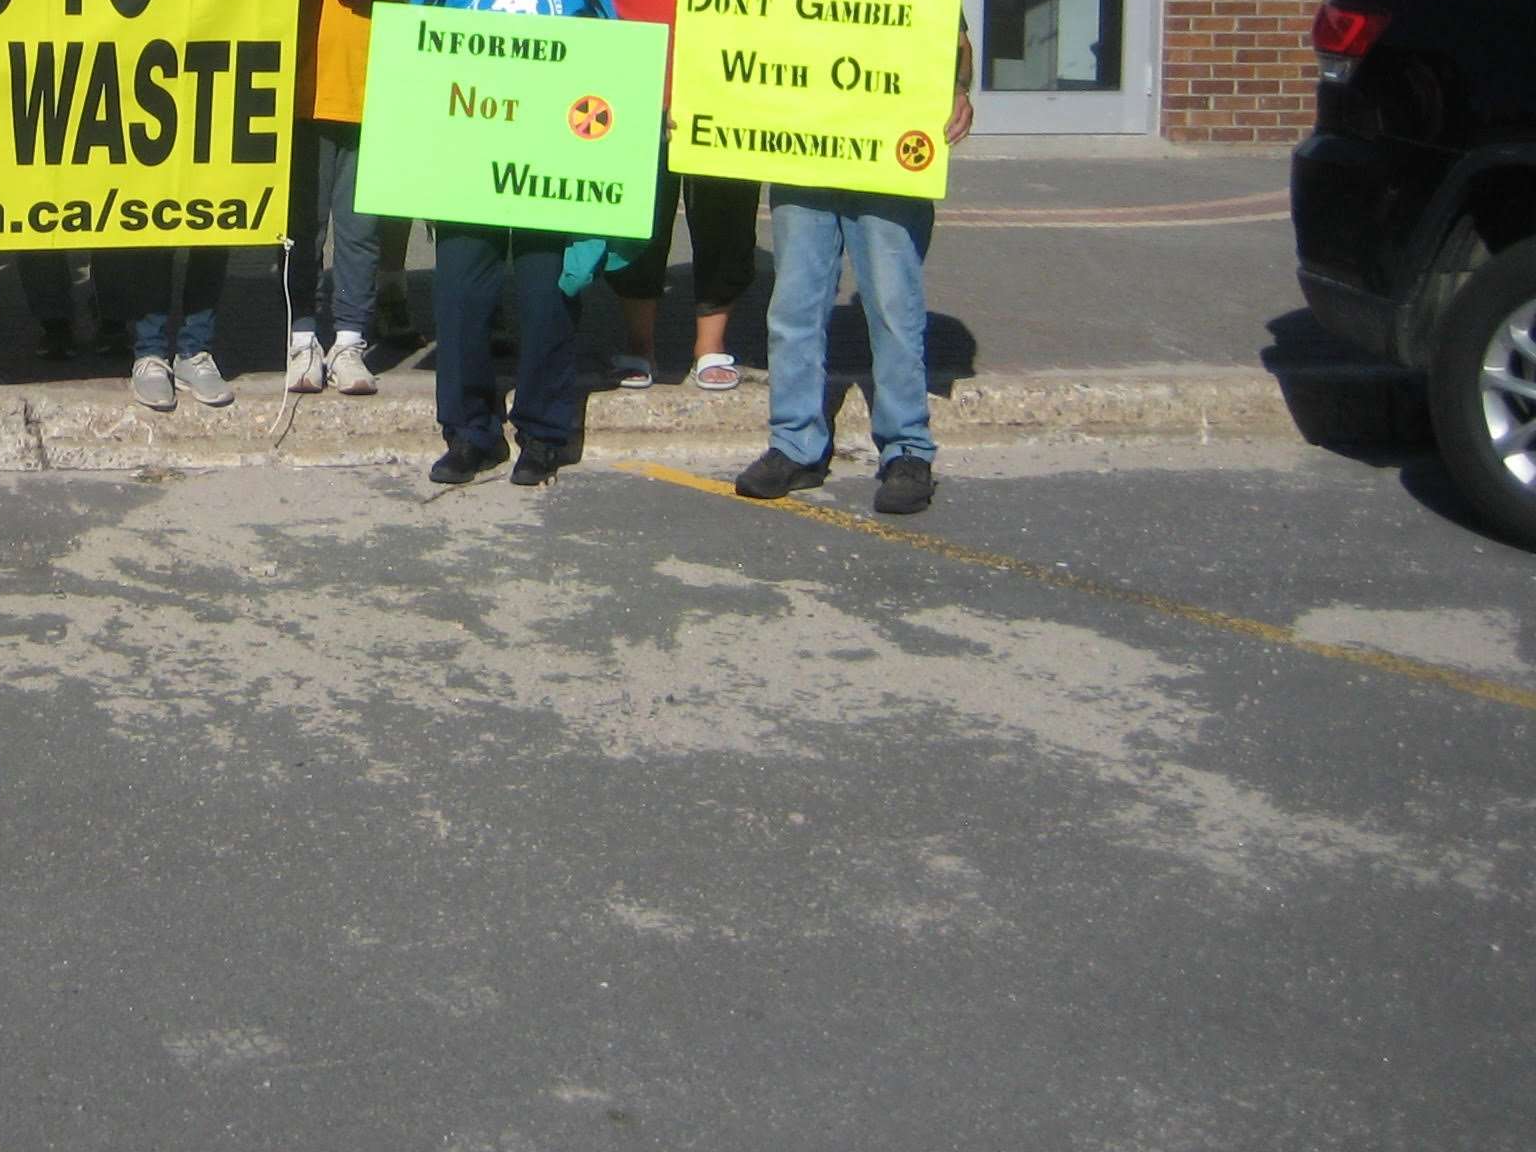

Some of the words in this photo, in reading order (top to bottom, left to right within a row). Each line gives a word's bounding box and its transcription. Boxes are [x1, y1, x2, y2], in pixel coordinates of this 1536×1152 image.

[418, 20, 567, 62] INFORMED
[721, 49, 808, 88] WITH
[8, 39, 282, 166] WASTE
[492, 160, 624, 205] WILLING
